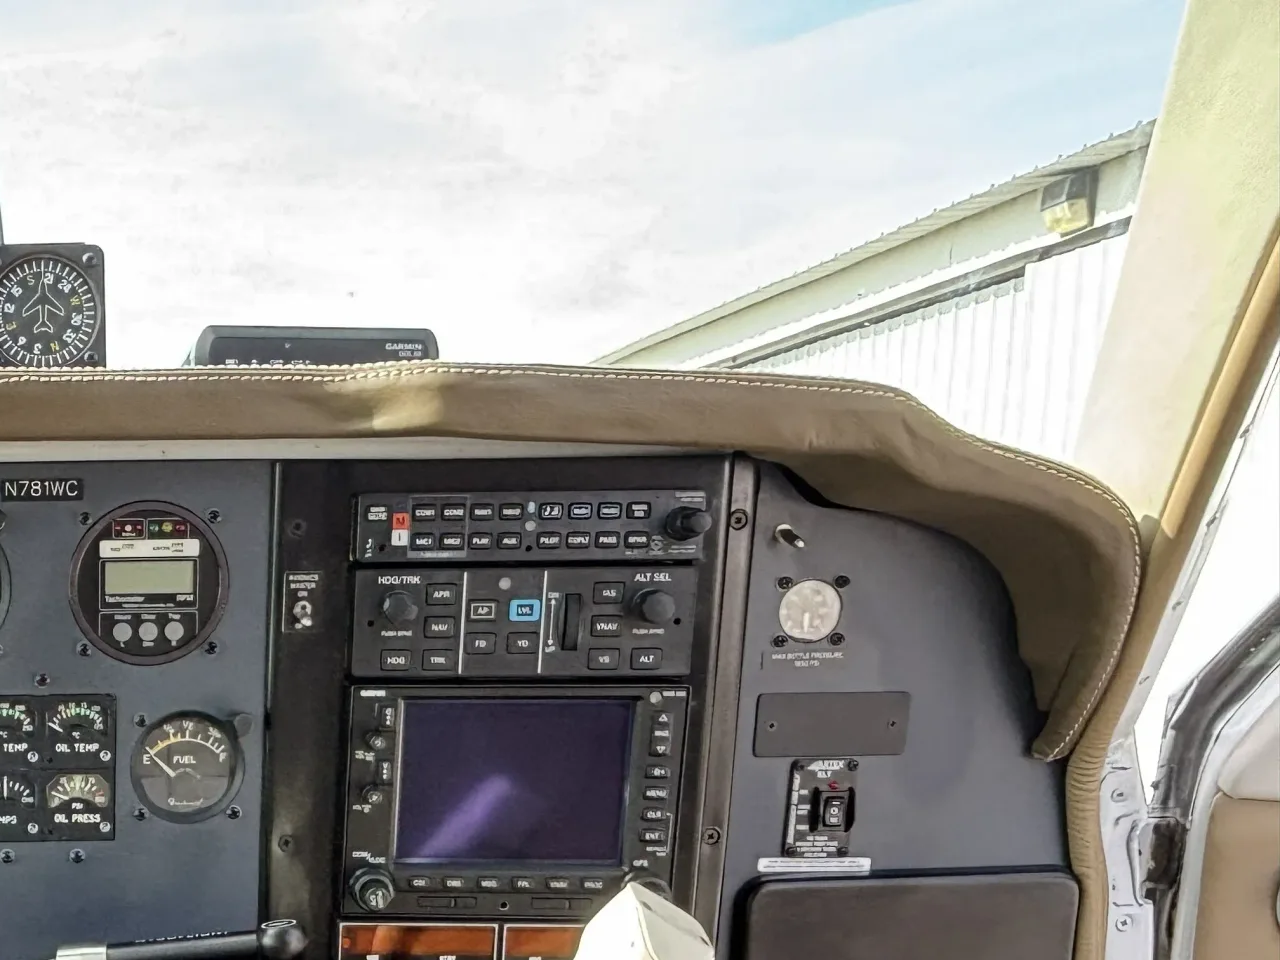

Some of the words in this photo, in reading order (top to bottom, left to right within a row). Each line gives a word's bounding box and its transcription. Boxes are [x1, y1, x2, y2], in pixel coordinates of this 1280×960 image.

[5, 480, 78, 497] N781WC
[634, 573, 651, 582] ALT
[653, 572, 672, 581] SEL
[639, 655, 655, 663] ALT
[3, 743, 29, 752] TEMP
[55, 743, 71, 753] OIL
[74, 743, 100, 752] TEMP
[142, 754, 151, 765] E
[172, 755, 197, 765] FUEL
[53, 814, 69, 823] OIL
[71, 813, 101, 823] PRESS
